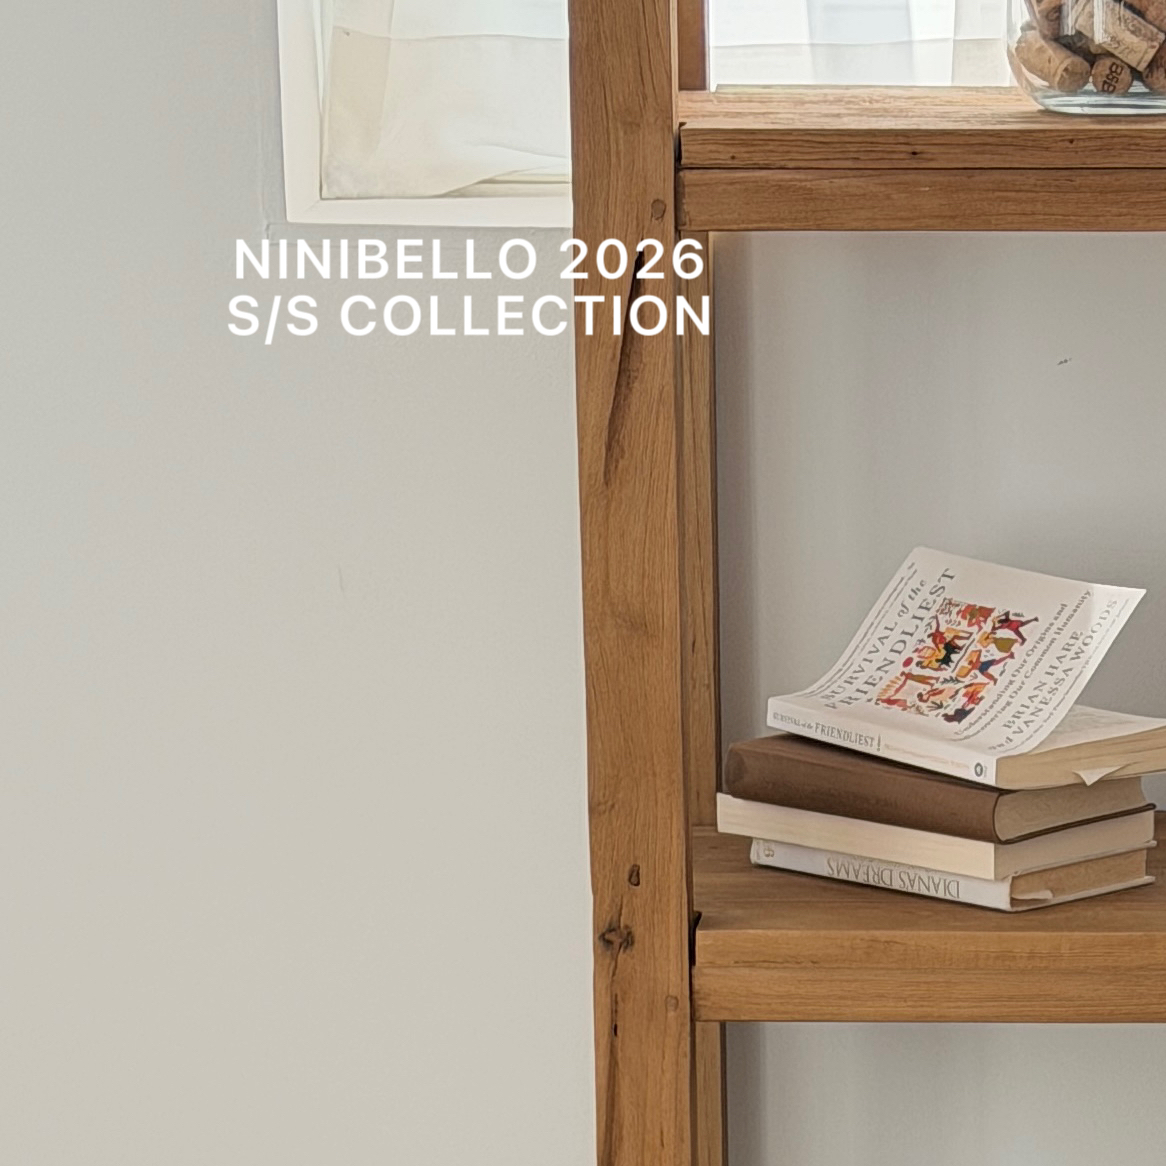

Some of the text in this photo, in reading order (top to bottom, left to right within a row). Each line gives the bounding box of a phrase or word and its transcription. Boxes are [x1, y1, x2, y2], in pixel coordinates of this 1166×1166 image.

[897, 602, 910, 618] of
[908, 580, 926, 601] the
[1003, 631, 1084, 729] BRIAN HARE
[1012, 667, 1073, 735] VANESSA
[1069, 599, 1118, 662] WOODS
[814, 722, 875, 748] FRIENDLIEST
[826, 857, 894, 887] DREAMS
